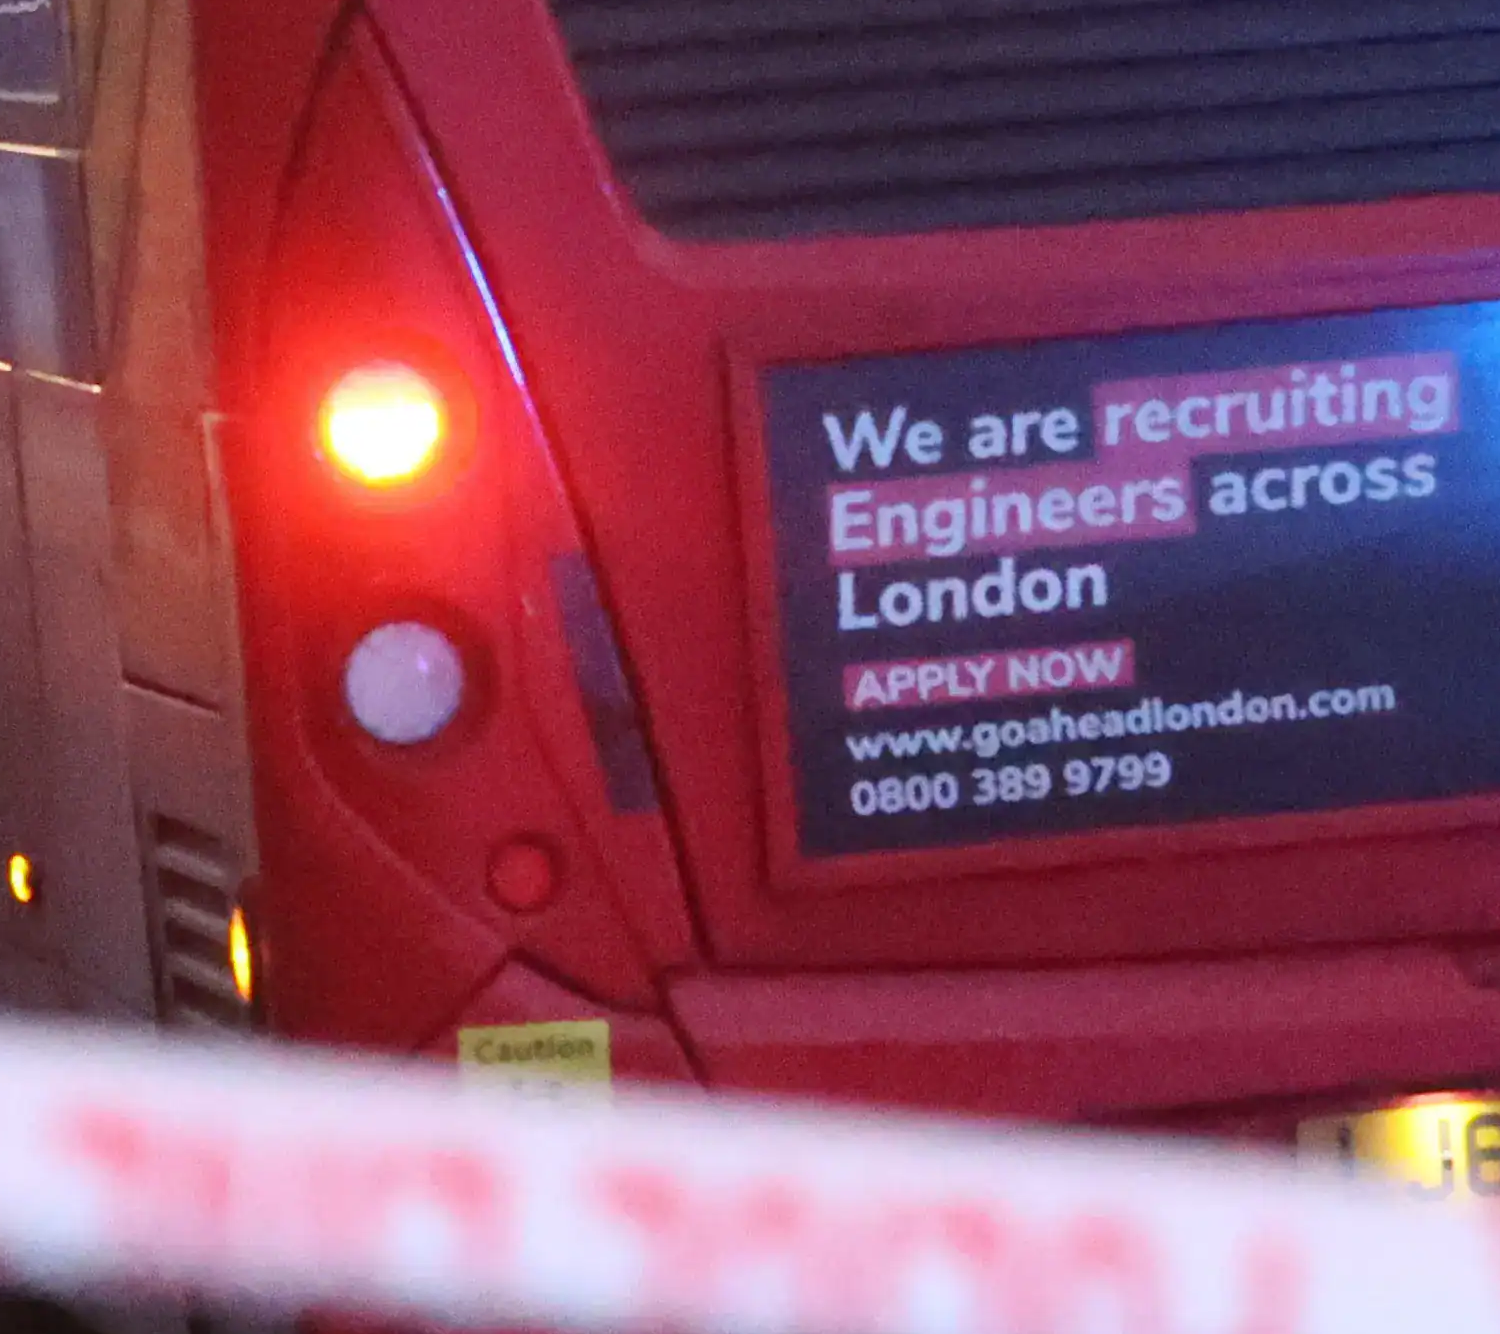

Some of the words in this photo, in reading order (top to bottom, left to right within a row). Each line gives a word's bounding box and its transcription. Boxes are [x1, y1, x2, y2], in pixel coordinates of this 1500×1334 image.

[822, 407, 943, 472] We
[968, 405, 1080, 459] are
[1102, 363, 1452, 448] recruiting
[831, 477, 1186, 557] Engineers
[1208, 453, 1438, 516] across
[836, 559, 1109, 631] London
[852, 658, 994, 707] APPLY
[1007, 646, 1125, 693] NOW
[846, 680, 1396, 762] www.goaheadlondon.com
[850, 772, 959, 817] 0800
[972, 762, 1051, 808] 389
[1062, 752, 1172, 795] 9799
[474, 1031, 595, 1066] Caution
